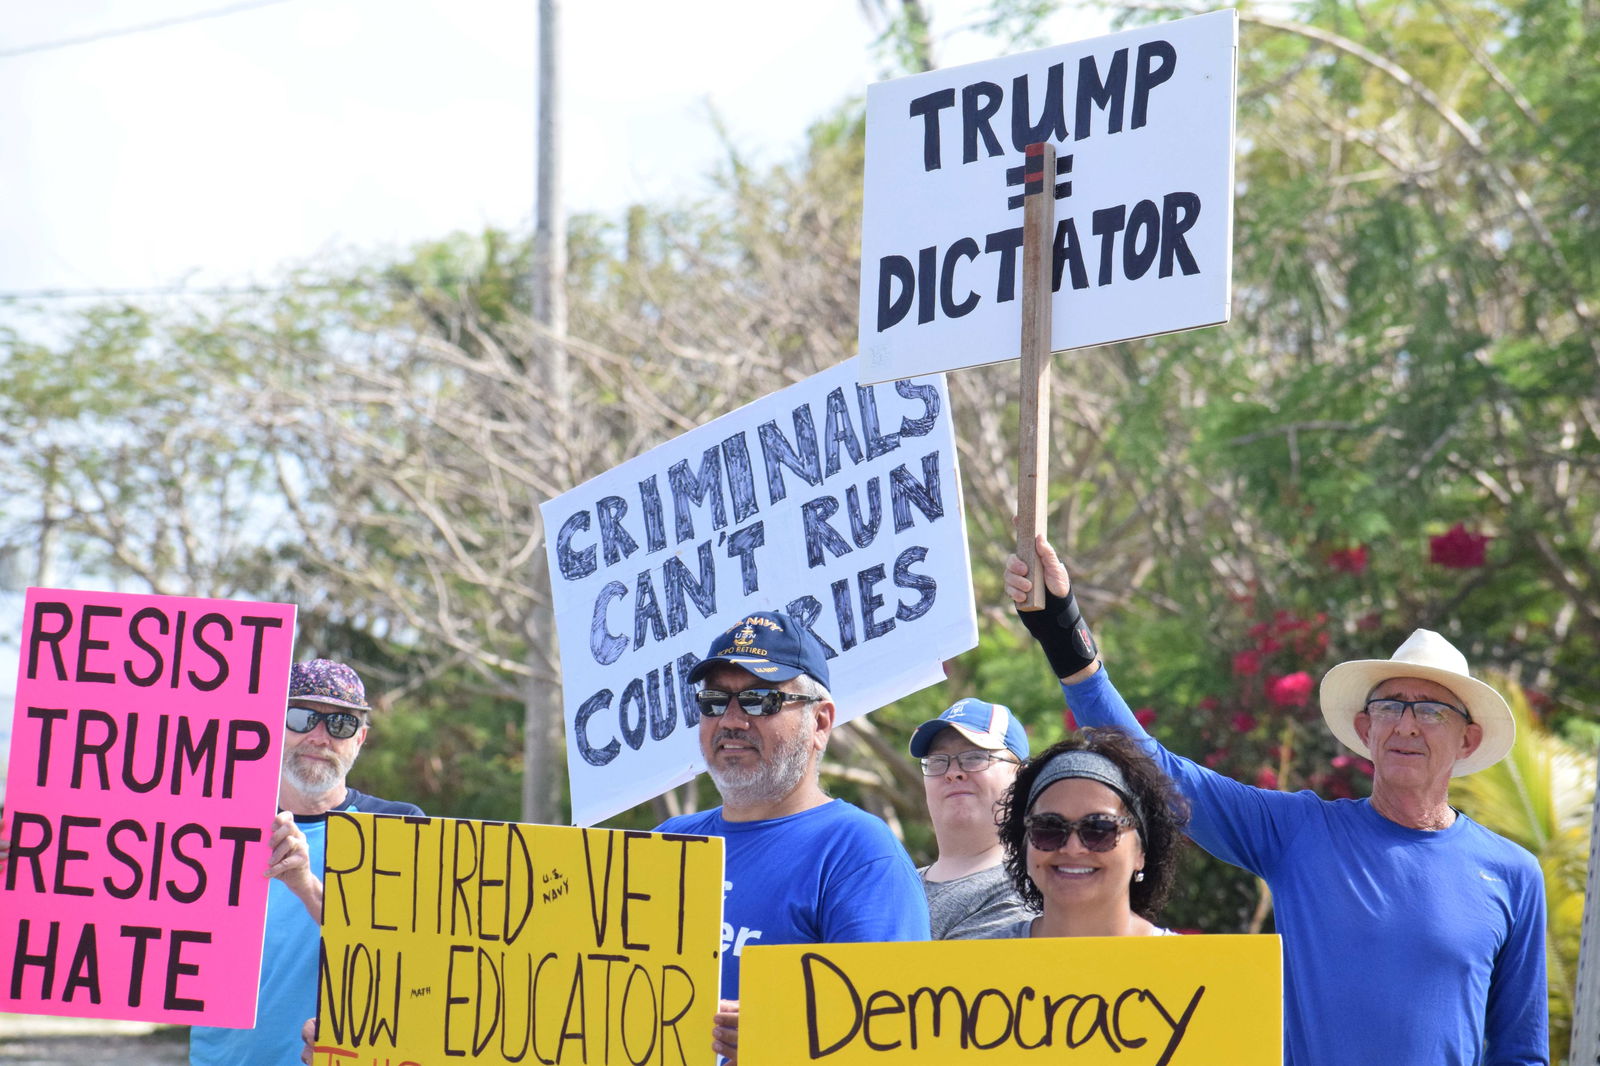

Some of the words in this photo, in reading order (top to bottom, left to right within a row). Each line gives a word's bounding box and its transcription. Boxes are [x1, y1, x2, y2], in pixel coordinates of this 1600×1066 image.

[910, 40, 1177, 172] TRUMP
[877, 192, 1201, 333] DICTATOR
[556, 379, 941, 581] CRIMINALS
[590, 520, 765, 666] CAN'T
[801, 450, 945, 569] RUN
[27, 602, 283, 695] RESIST
[574, 545, 938, 767] COURIES
[736, 646, 768, 656] RETIRED
[27, 707, 271, 799] TRUMP
[5, 812, 262, 907] RESIST
[320, 811, 534, 945] RETIRED
[543, 877, 569, 904] NAVY
[11, 919, 212, 1012] HATE
[314, 936, 402, 1048] NOW
[410, 986, 431, 998] MATH
[444, 945, 695, 1066] EDUCATOR
[801, 952, 1206, 1066] Democracy
